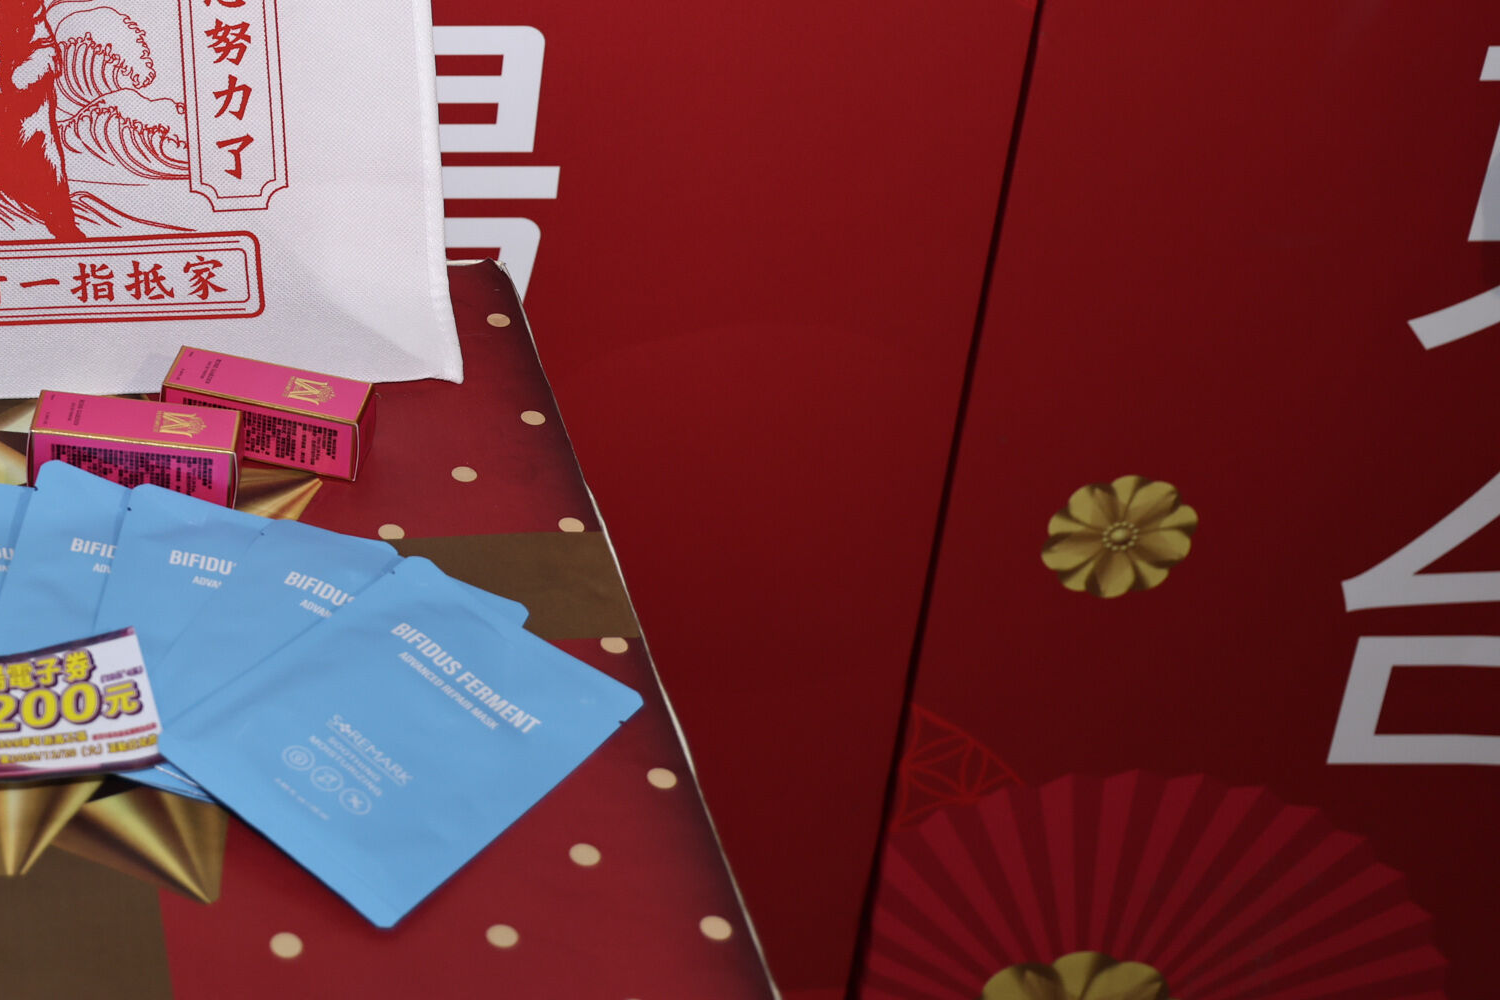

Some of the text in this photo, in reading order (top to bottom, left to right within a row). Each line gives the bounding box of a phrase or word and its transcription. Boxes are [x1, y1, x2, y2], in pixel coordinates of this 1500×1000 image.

[168, 549, 237, 576] BIFIDU
[284, 571, 355, 607] BIFIDU
[390, 622, 542, 734] BIFIDUS FERMENT
[398, 651, 445, 688] ADVANCED
[470, 707, 499, 731] MASK
